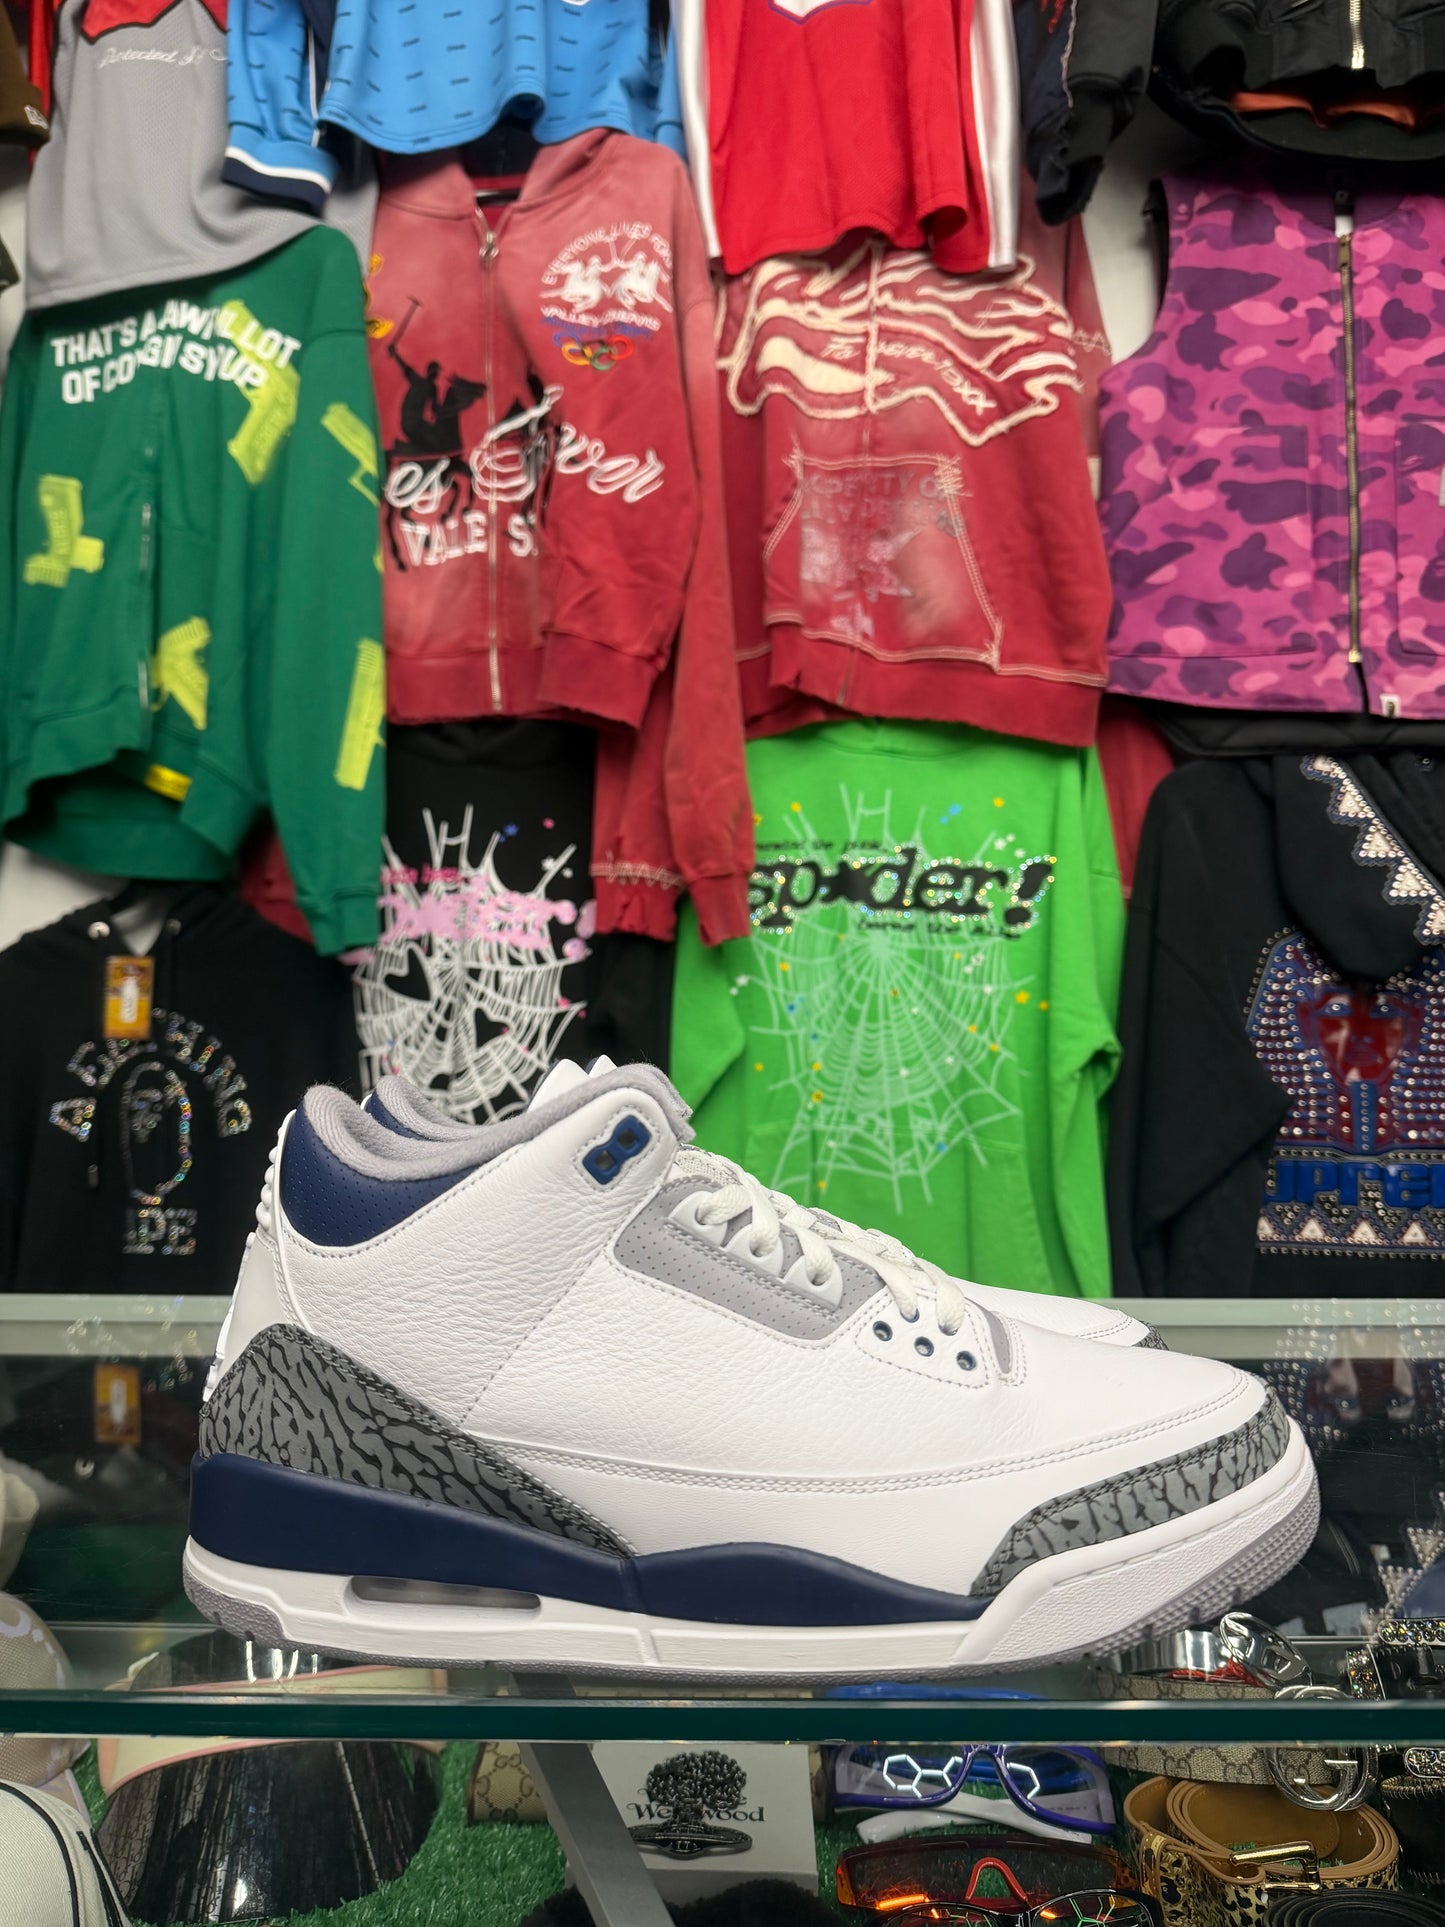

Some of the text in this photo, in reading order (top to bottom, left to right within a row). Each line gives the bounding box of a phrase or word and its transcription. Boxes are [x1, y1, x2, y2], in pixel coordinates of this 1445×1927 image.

[50, 316, 138, 367] THAT'S
[139, 308, 157, 341] A
[238, 321, 302, 369] LOT
[62, 369, 101, 404] OF
[626, 1802, 767, 1823] Wewood
